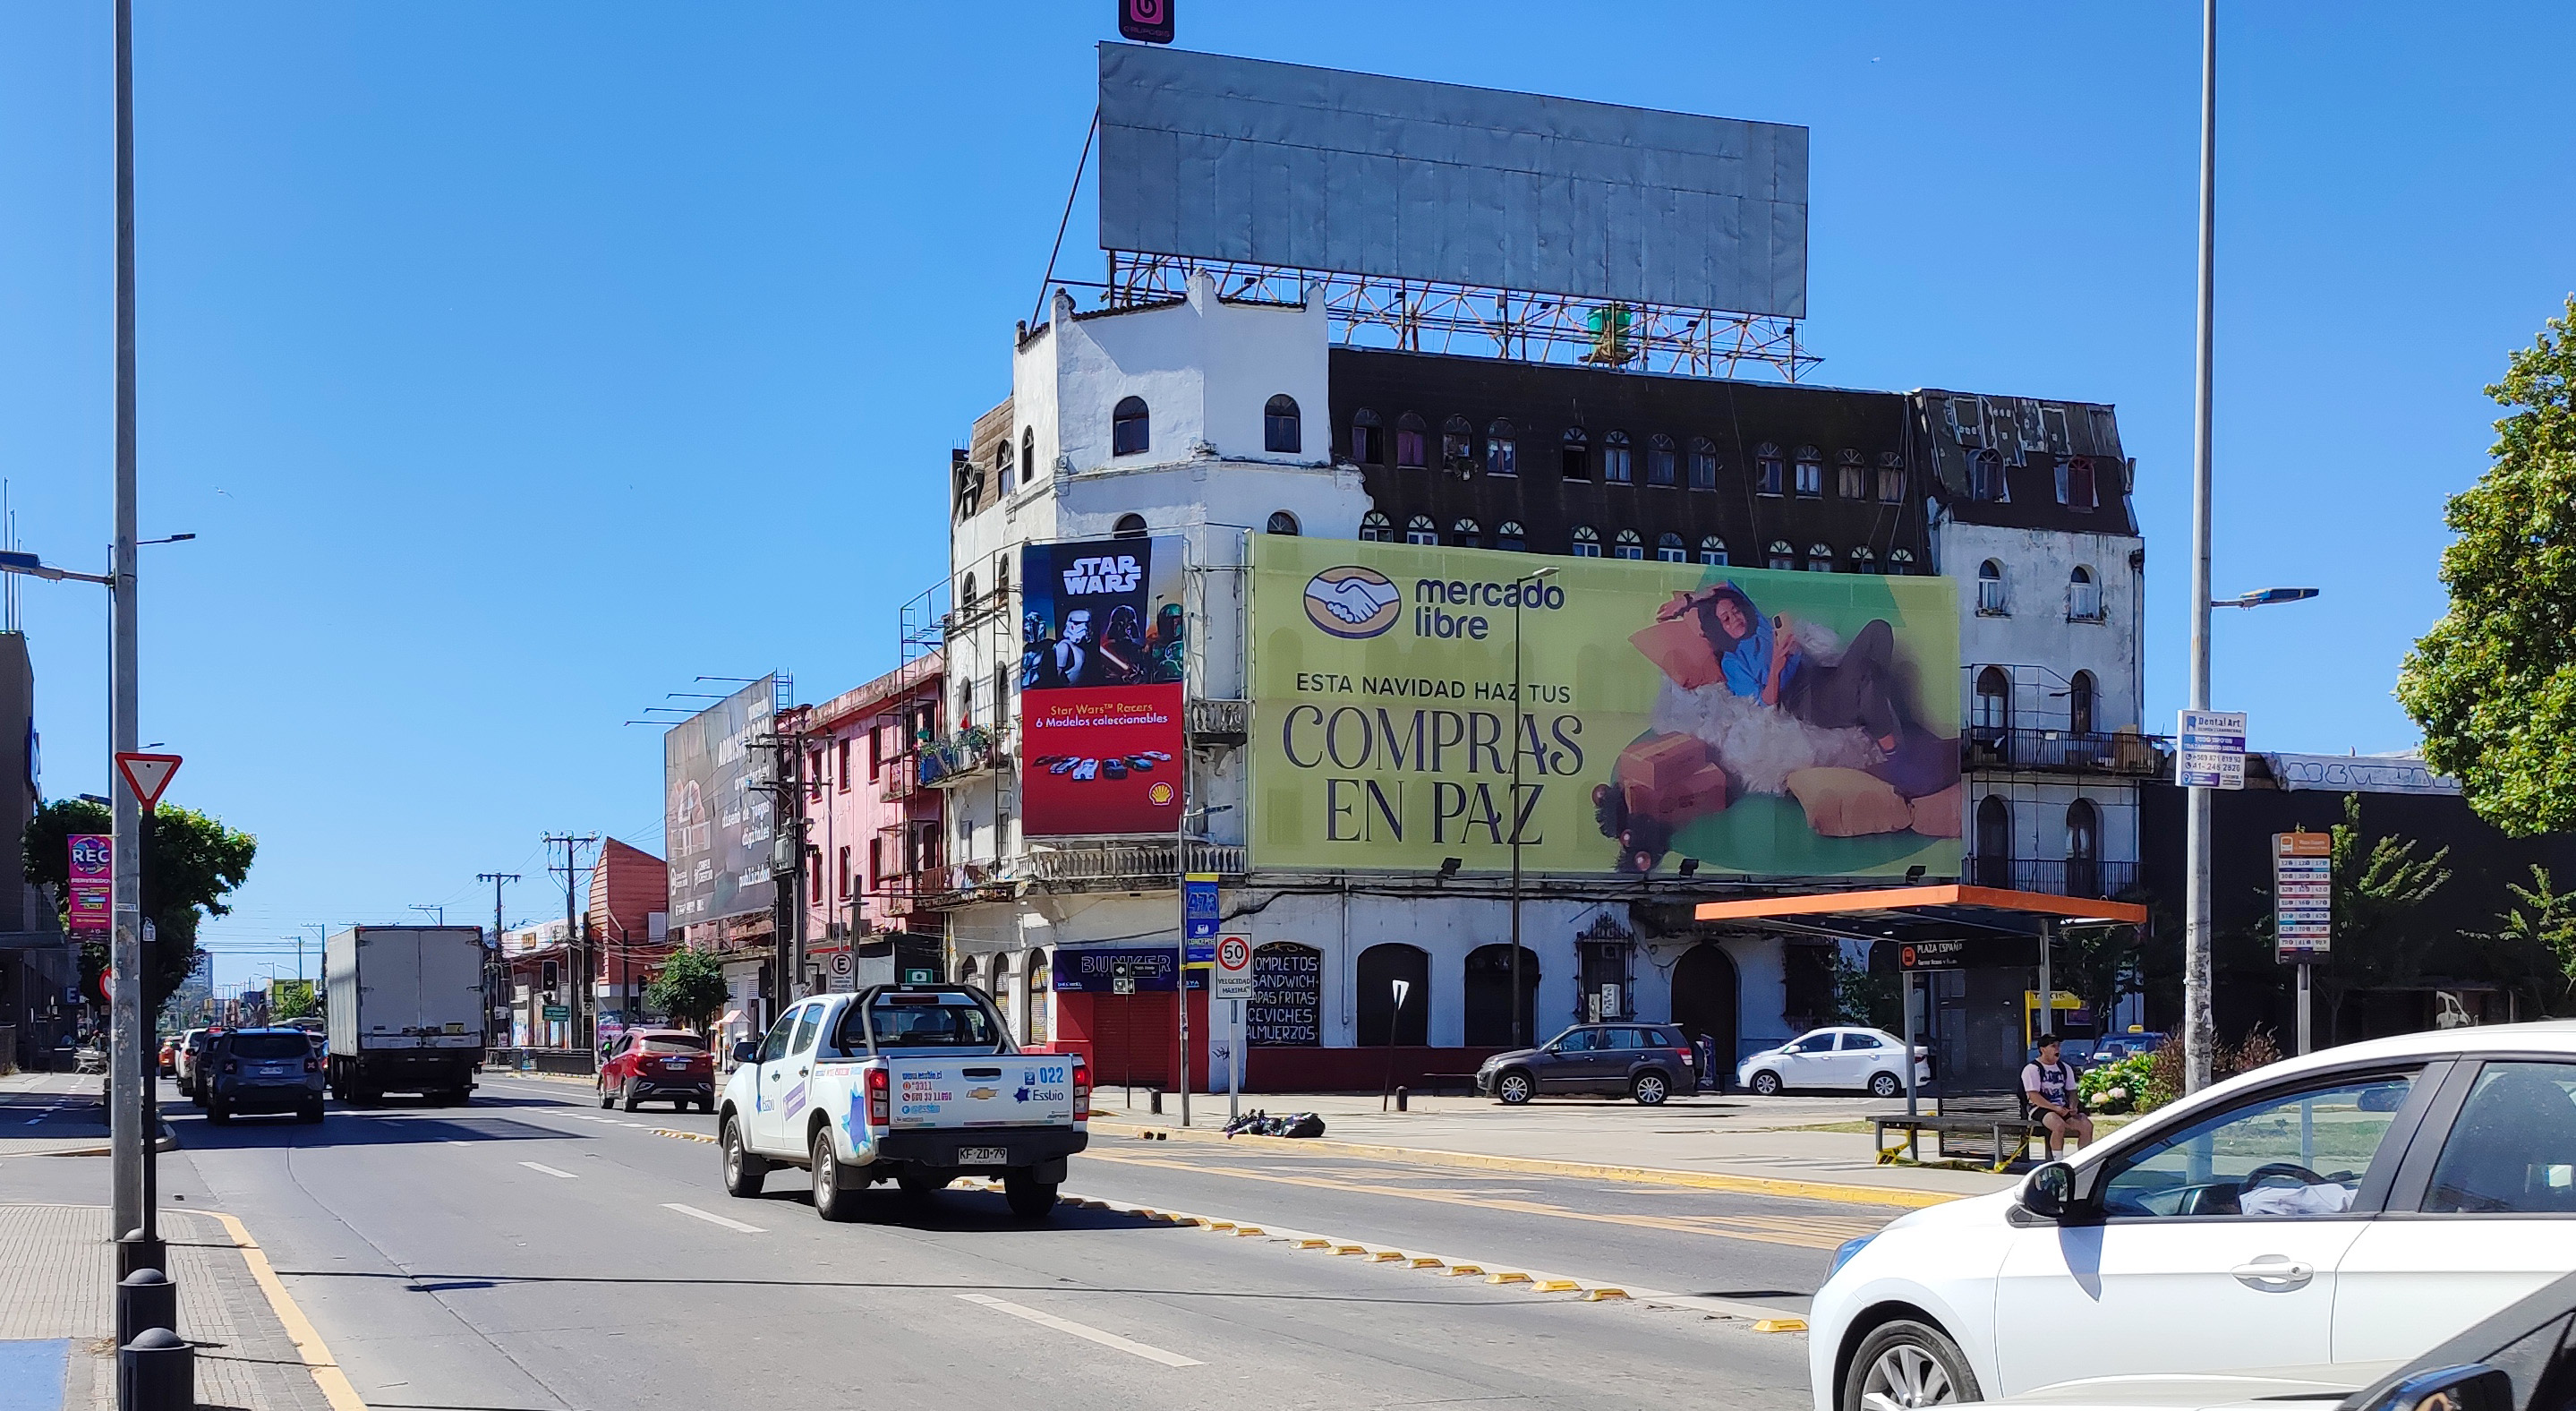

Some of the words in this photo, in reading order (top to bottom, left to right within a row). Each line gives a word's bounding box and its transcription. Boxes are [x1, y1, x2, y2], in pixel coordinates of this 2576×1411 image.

[1063, 555, 1141, 577] STAR
[1063, 573, 1141, 595] WARS
[1415, 578, 1565, 610] mercado
[1415, 606, 1488, 640] libre
[1296, 672, 1353, 694] ESTA
[1362, 676, 1466, 698] NAVIDAD
[1474, 681, 1518, 702] HAZ
[1527, 684, 1571, 704] TUS
[1051, 706, 1073, 715] Star
[1117, 703, 1153, 714] Racers
[1036, 717, 1044, 728] 6
[1045, 714, 1090, 727] Modelos
[1092, 713, 1168, 727] coleccionables
[2197, 717, 2226, 726] Dental
[2228, 719, 2240, 728] Art
[1283, 705, 1583, 776] COMPRAS
[1326, 778, 1405, 843] EN
[1431, 781, 1545, 845] PAZ
[742, 821, 770, 850] digitales
[73, 849, 110, 863] REC
[1224, 945, 1244, 960] 50
[1917, 943, 1938, 953] PLAZA
[837, 958, 847, 971] E
[1253, 956, 1318, 971] OMPLETOS
[1253, 973, 1315, 988] SANDWICH
[1251, 991, 1276, 1005] APAS
[1278, 991, 1317, 1005] FRITAS
[1248, 1007, 1313, 1024] CEVICHES
[1246, 1025, 1316, 1040] ALMUERZOS
[1039, 1066, 1063, 1083] 022
[1032, 1089, 1064, 1101] Essbio
